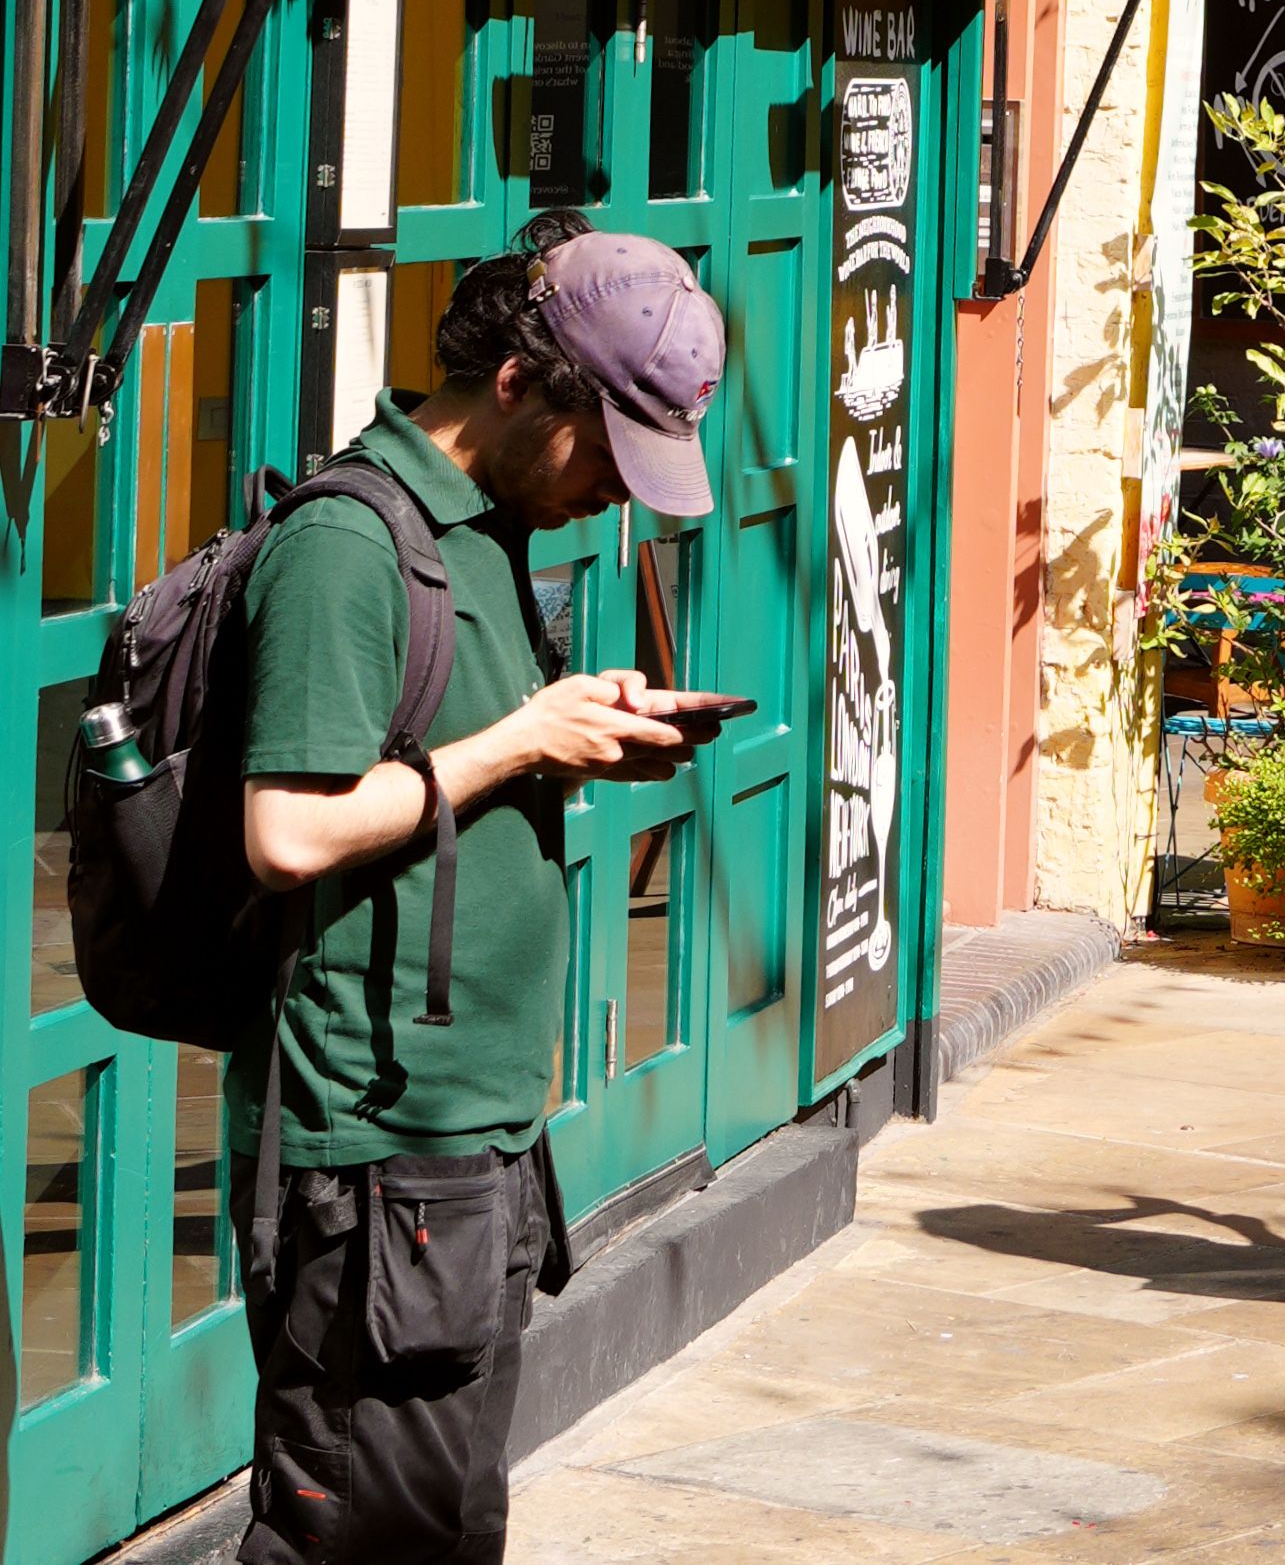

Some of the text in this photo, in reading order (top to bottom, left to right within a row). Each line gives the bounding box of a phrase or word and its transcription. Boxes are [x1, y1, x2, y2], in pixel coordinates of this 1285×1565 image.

[842, 5, 916, 61] WINE BAR
[832, 557, 872, 747] PARIS
